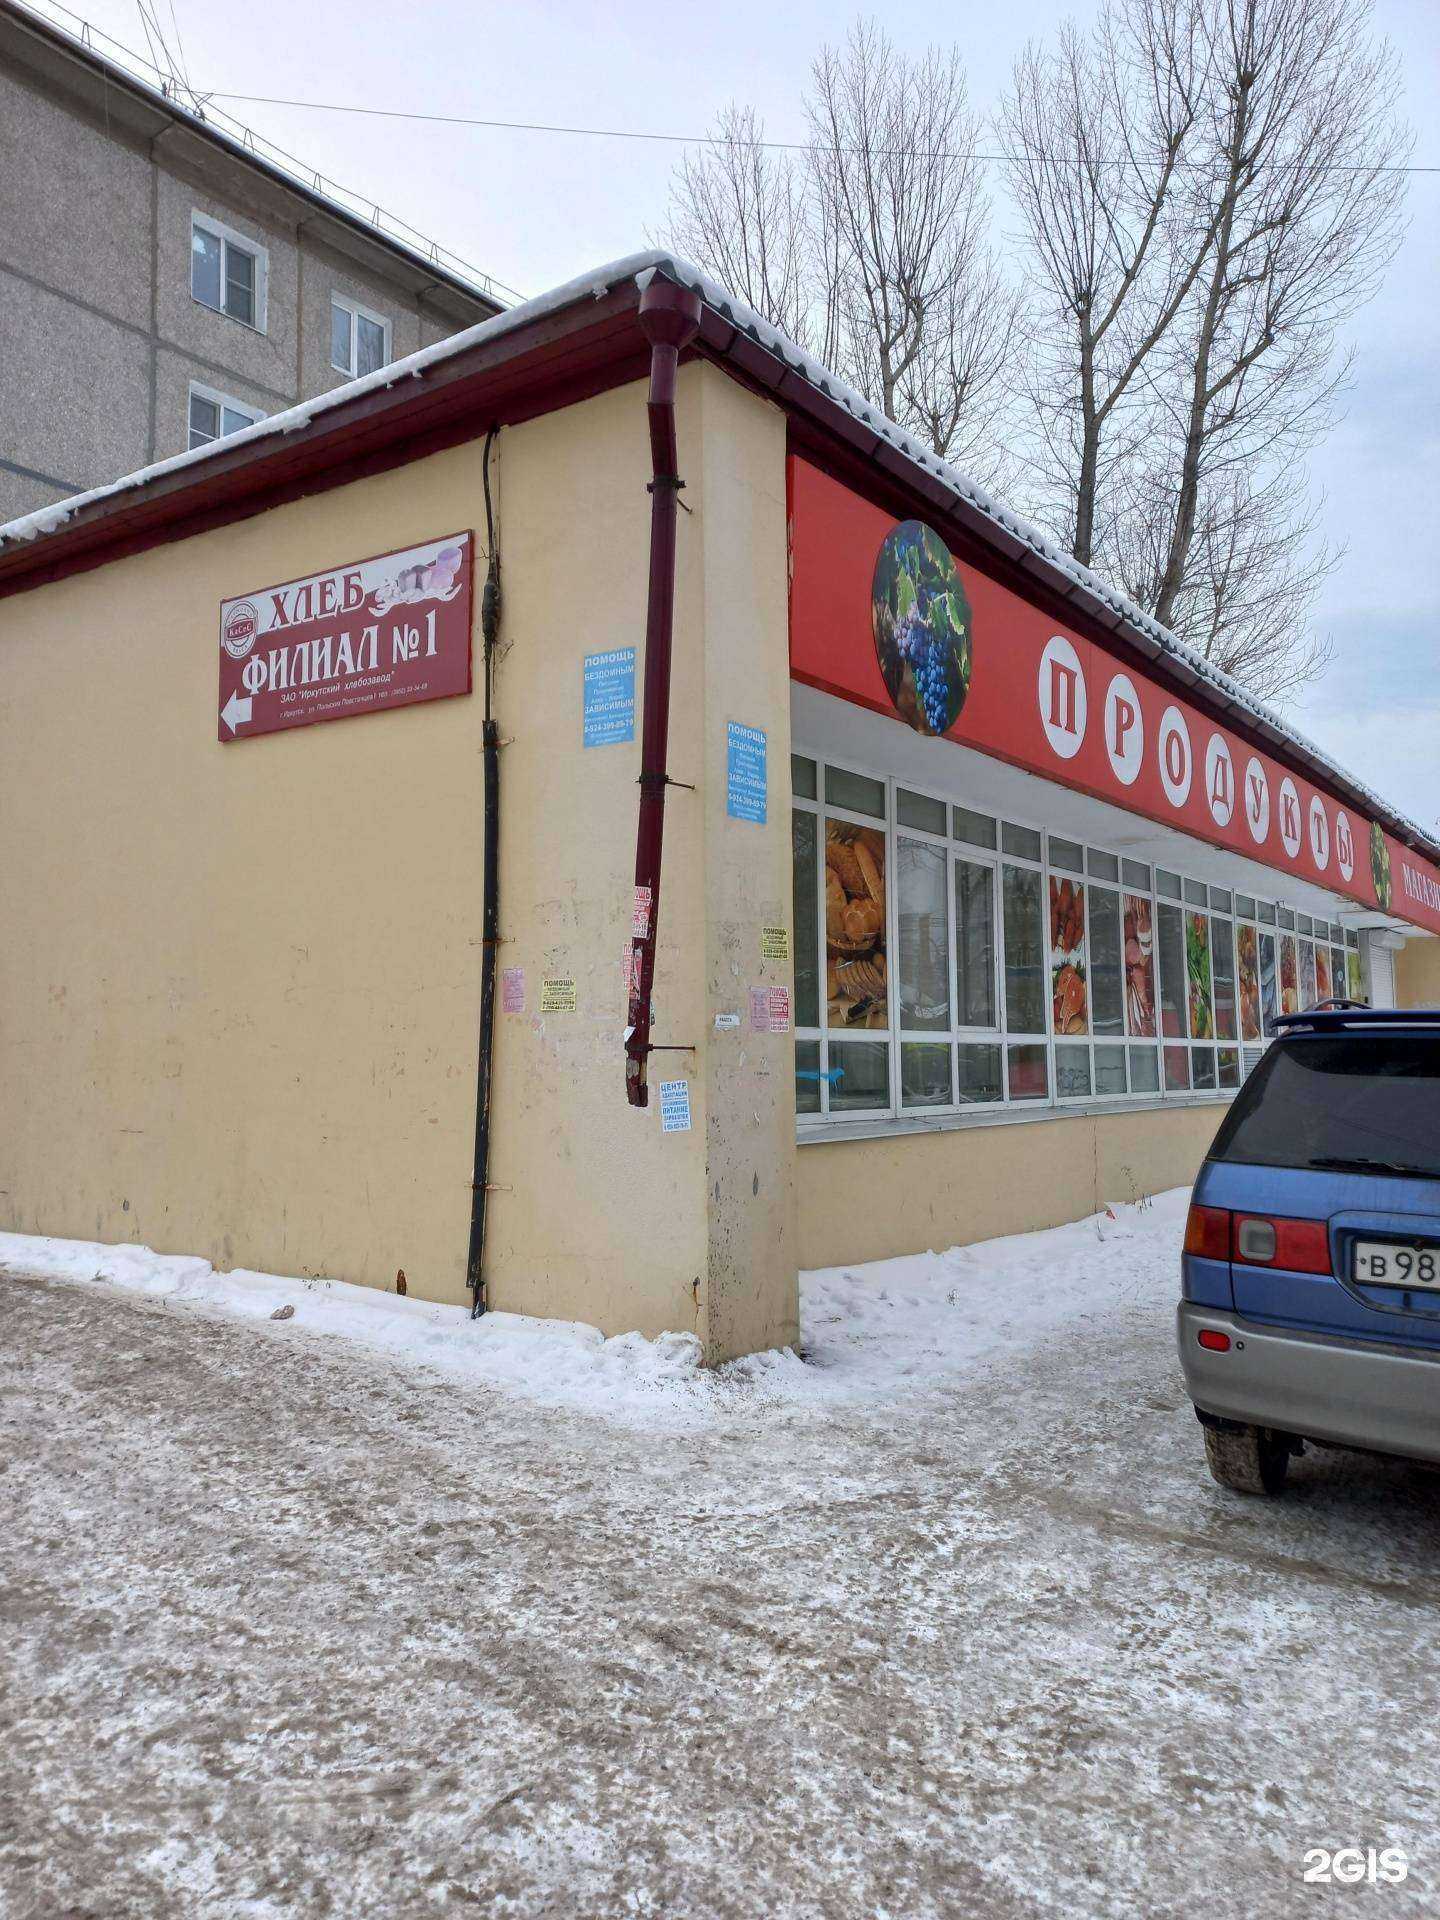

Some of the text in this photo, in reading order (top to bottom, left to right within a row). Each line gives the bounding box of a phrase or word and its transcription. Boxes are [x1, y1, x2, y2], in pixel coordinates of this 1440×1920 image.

[268, 570, 365, 632] ХЛЕБ
[242, 625, 380, 695] ФИЛИАЛ
[585, 650, 634, 667] ПОМОЩЬ
[585, 665, 634, 681] БЕЗДОМНЫМ
[280, 692, 296, 704] ЗАО
[585, 698, 634, 714] ЗАВИСИМЫМ
[728, 723, 766, 744] ПОМОЩЬ
[1049, 658, 1353, 867] ПРОДУКТЫ
[763, 927, 787, 936] ПОМОЩЬ
[661, 1082, 687, 1092] ЦЕНТР
[663, 1106, 688, 1115] ПИТАНИЕ
